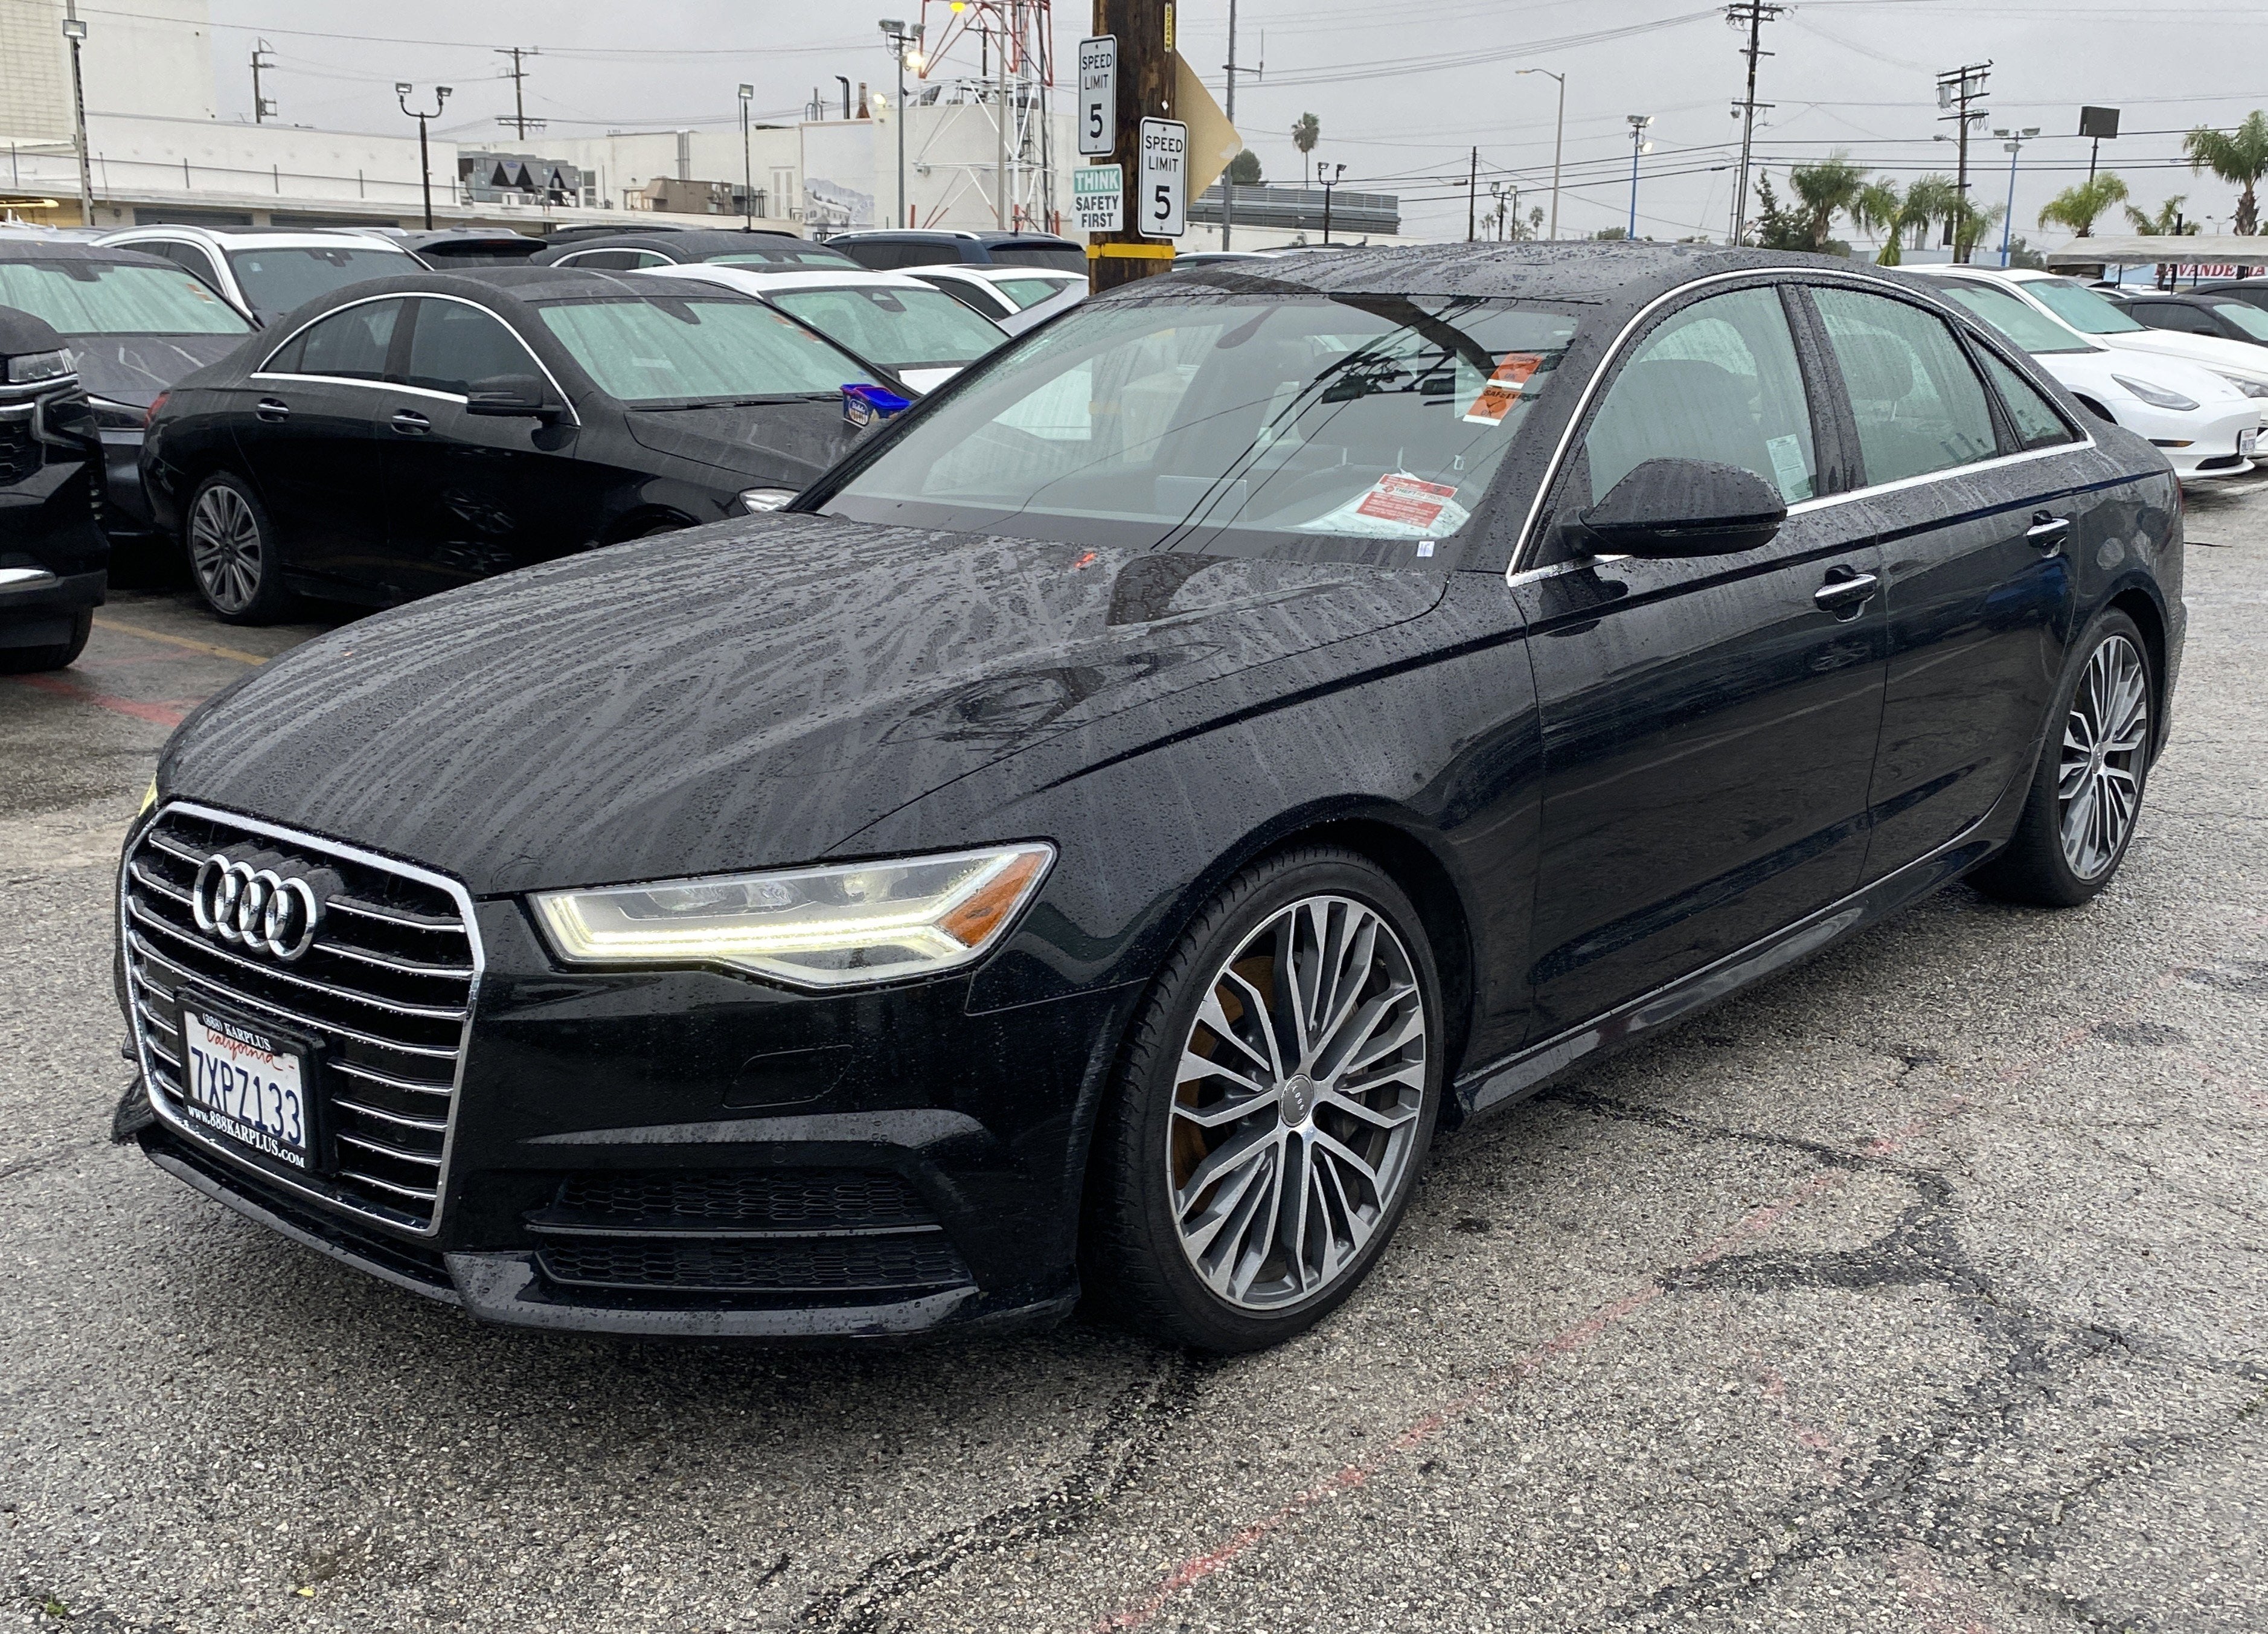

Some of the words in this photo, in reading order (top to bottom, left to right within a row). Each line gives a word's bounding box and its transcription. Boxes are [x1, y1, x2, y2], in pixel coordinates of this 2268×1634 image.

[1082, 53, 1112, 70] SPEED
[1084, 74, 1109, 91] LIMIT
[1089, 103, 1103, 138] 5
[1145, 135, 1184, 153] SPEED
[1148, 155, 1179, 173] LIMIT
[1075, 171, 1120, 191] THINK
[1075, 194, 1119, 211] SAFETY
[1154, 185, 1171, 220] 5
[1081, 213, 1113, 228] FIRST
[2154, 264, 2266, 277] AVANDEIA
[223, 1022, 272, 1051] KARPLUS
[207, 1028, 283, 1071] California
